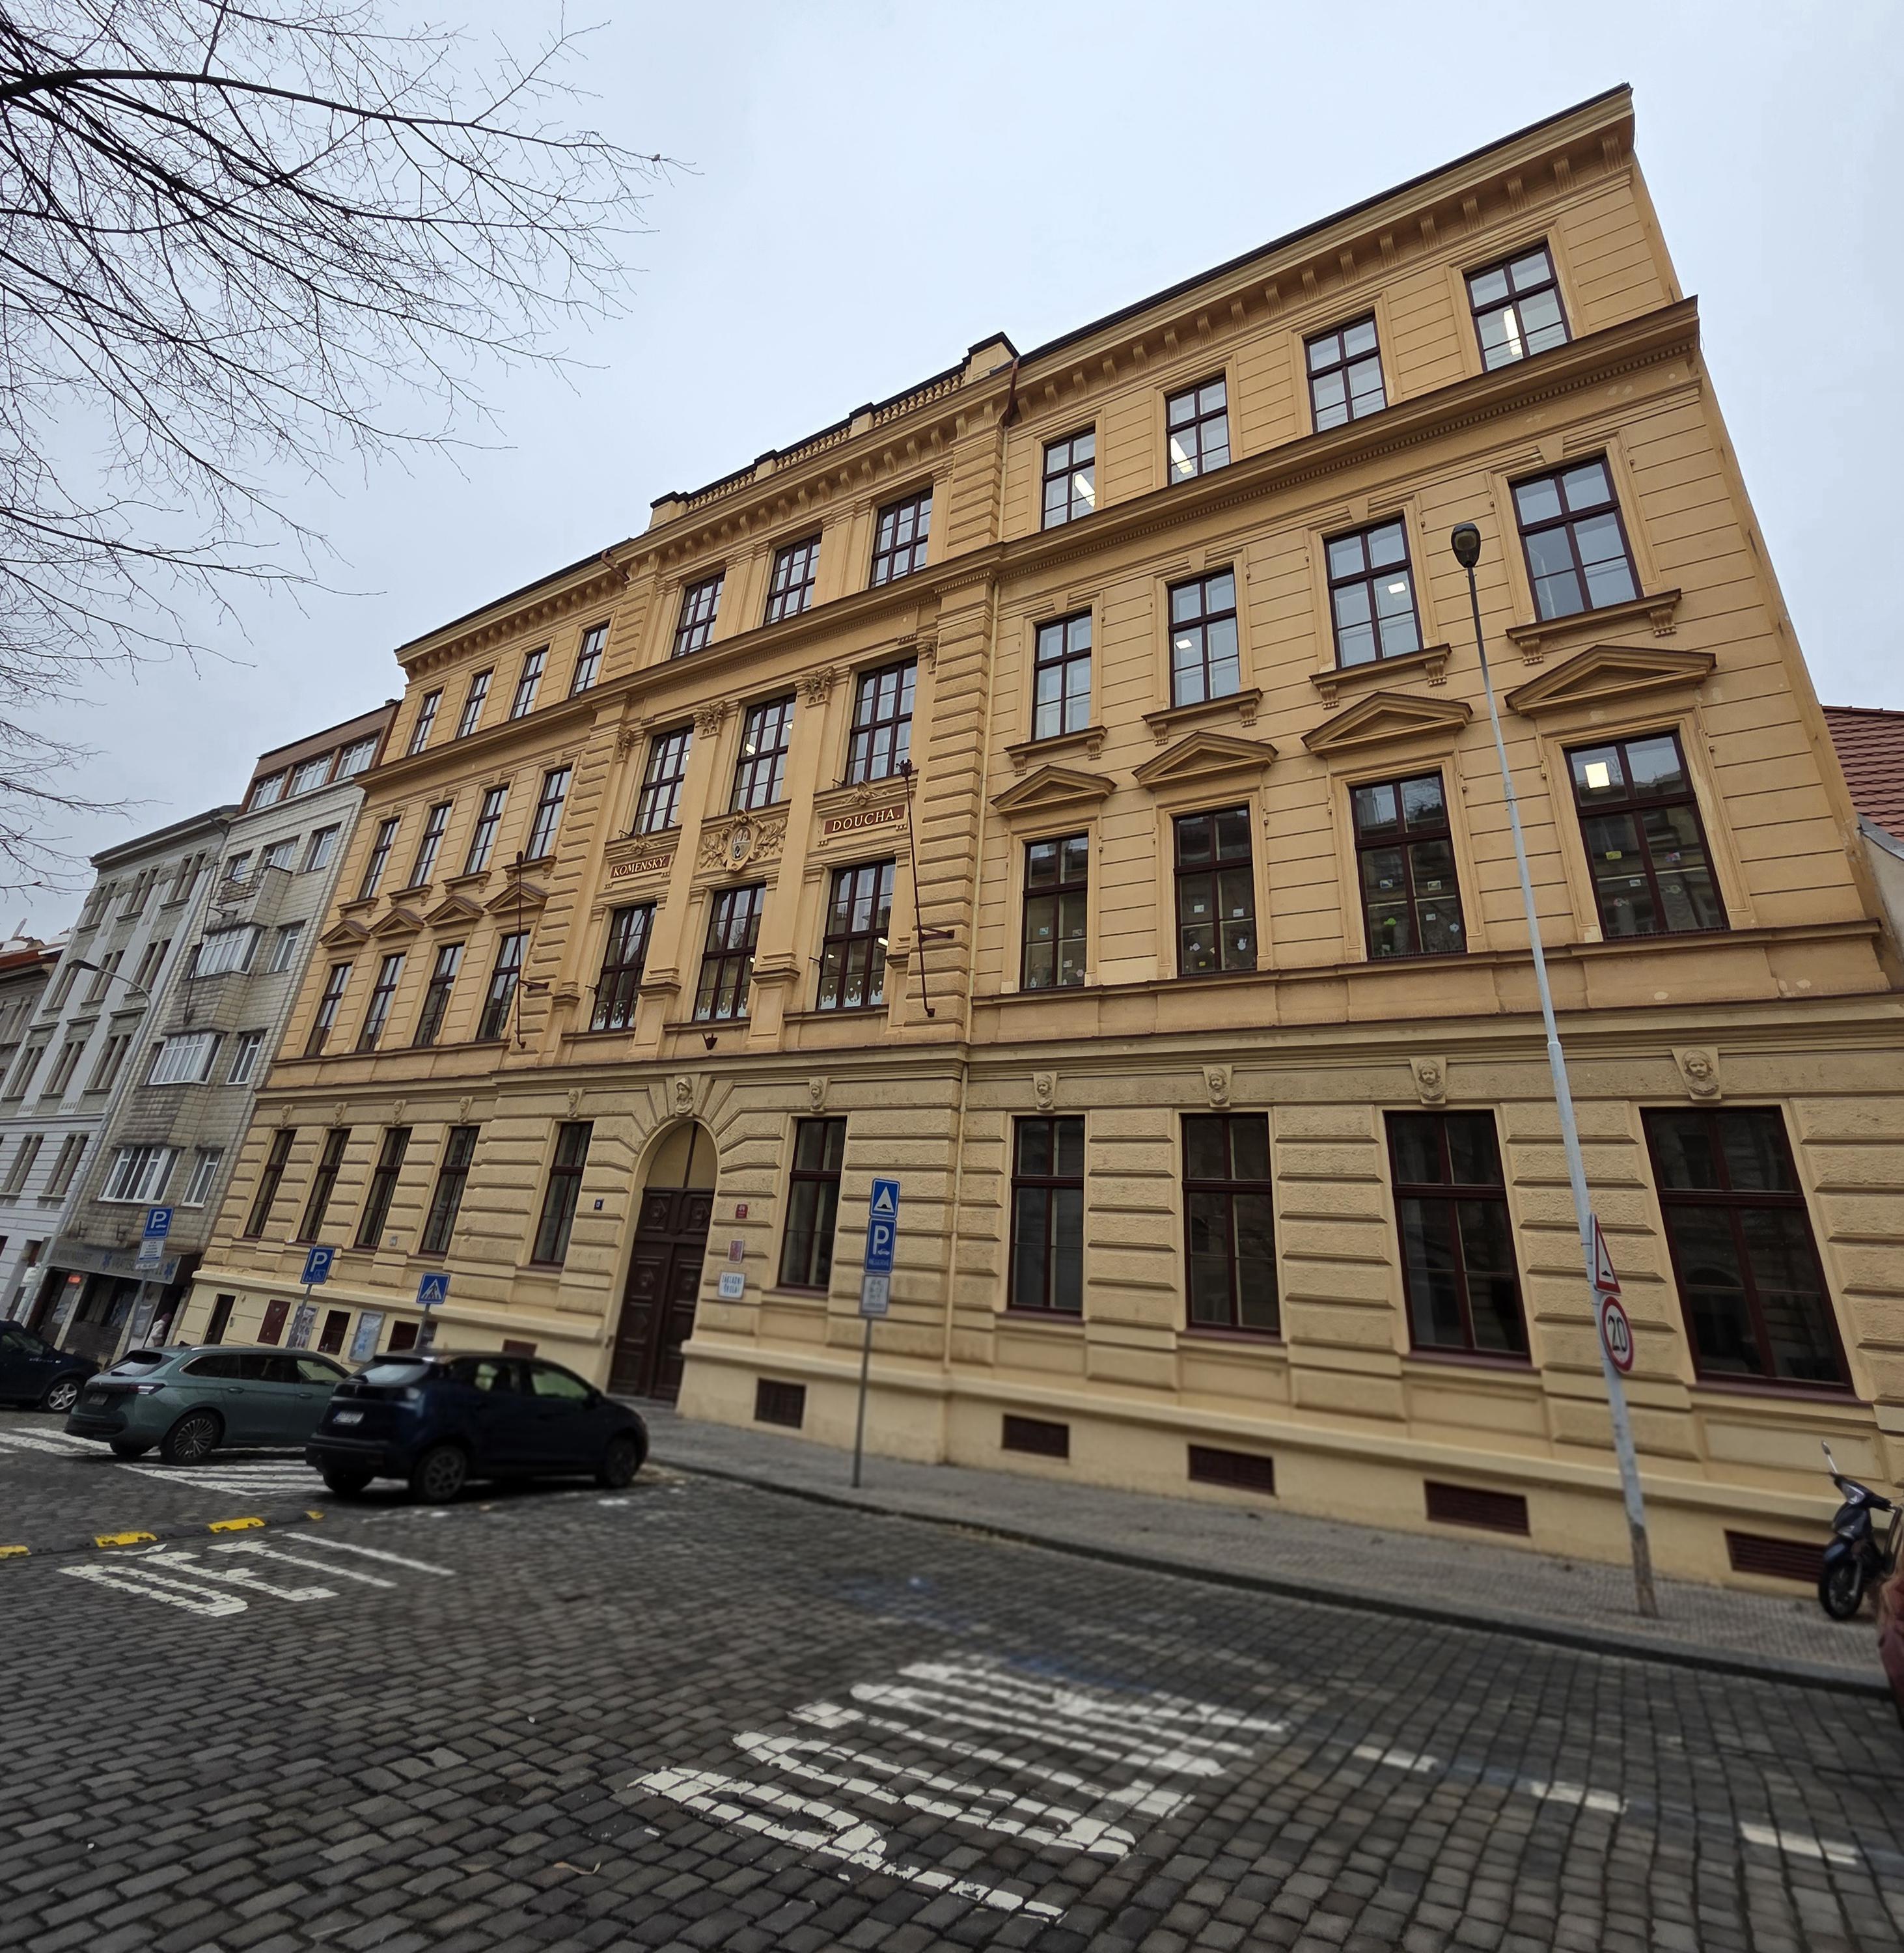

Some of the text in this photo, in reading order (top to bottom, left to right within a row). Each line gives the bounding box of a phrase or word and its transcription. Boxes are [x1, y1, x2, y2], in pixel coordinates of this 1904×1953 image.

[150, 1211, 167, 1228] P
[872, 1225, 889, 1255] P
[310, 1252, 327, 1272] P
[1607, 1314, 1628, 1352] 20
